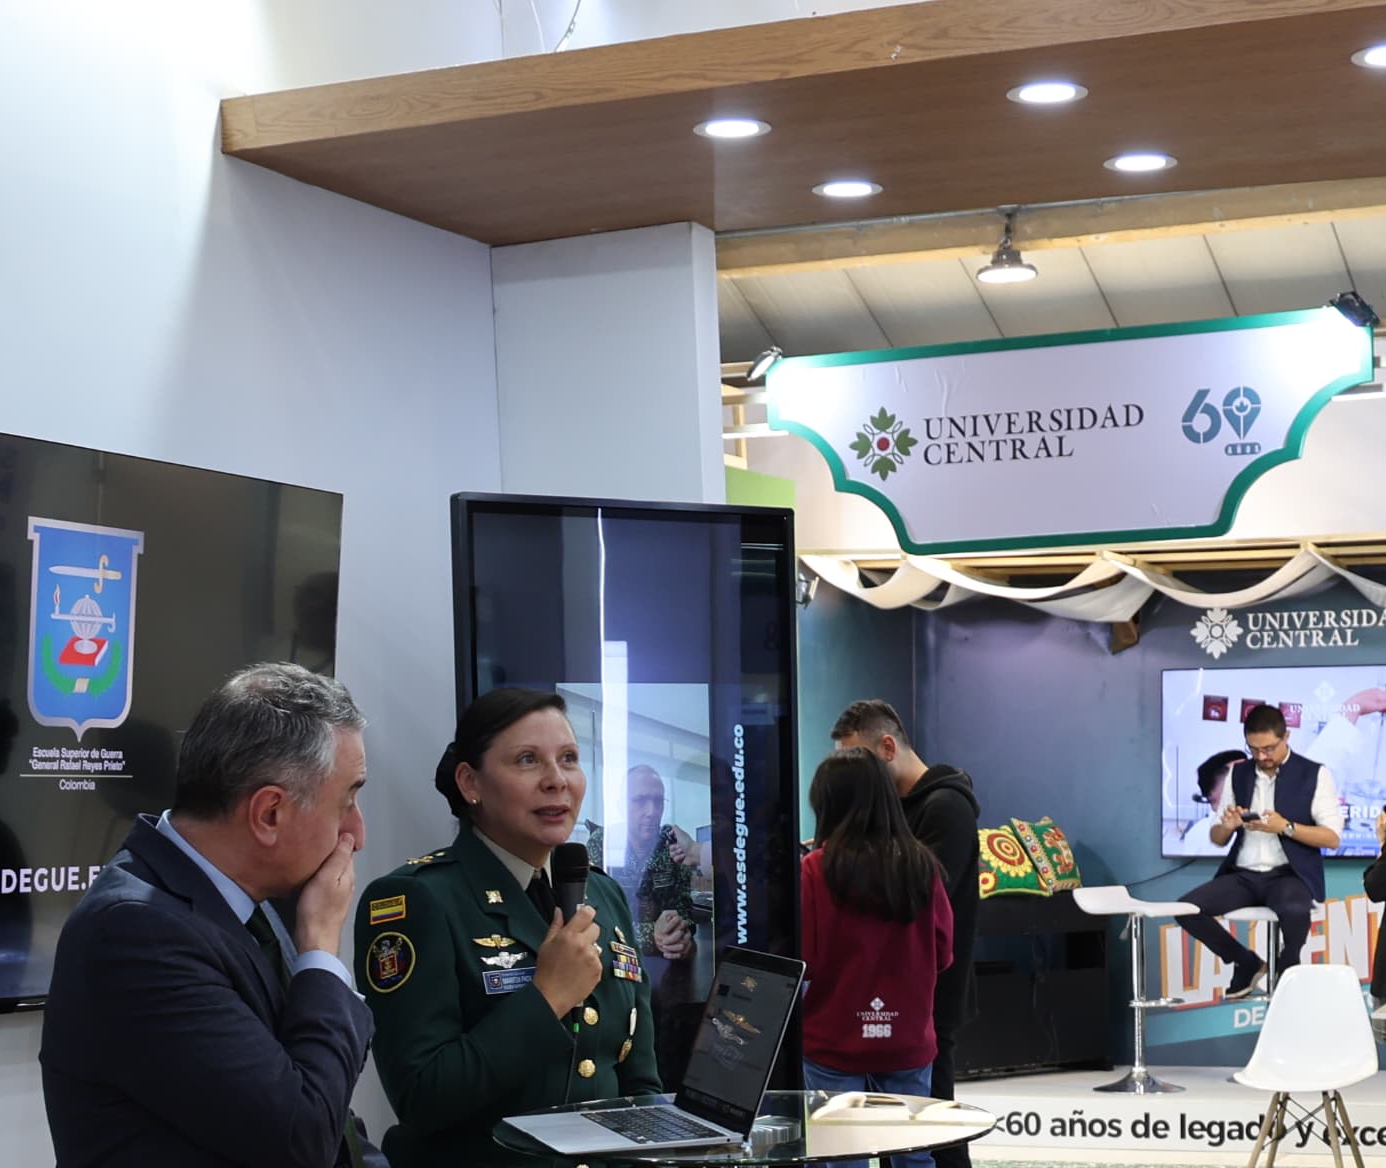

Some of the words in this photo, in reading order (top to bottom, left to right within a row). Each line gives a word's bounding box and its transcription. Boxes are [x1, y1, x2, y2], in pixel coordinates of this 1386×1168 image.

[923, 403, 1145, 441] UNIVERSIDAD
[923, 434, 1075, 466] CENTRAL
[1246, 629, 1359, 649] CENTRAL
[33, 746, 60, 758] Escuela
[61, 747, 90, 760] Superior
[90, 748, 99, 759] de
[100, 748, 123, 759] Guerra
[60, 759, 82, 771] Rafael
[82, 760, 102, 773] Reyes
[59, 779, 96, 790] Colombia
[732, 723, 748, 945] www.esdegue.edu.co
[1050, 1110, 1123, 1138] años
[1131, 1112, 1170, 1139] de
[1295, 1120, 1313, 1147] y
